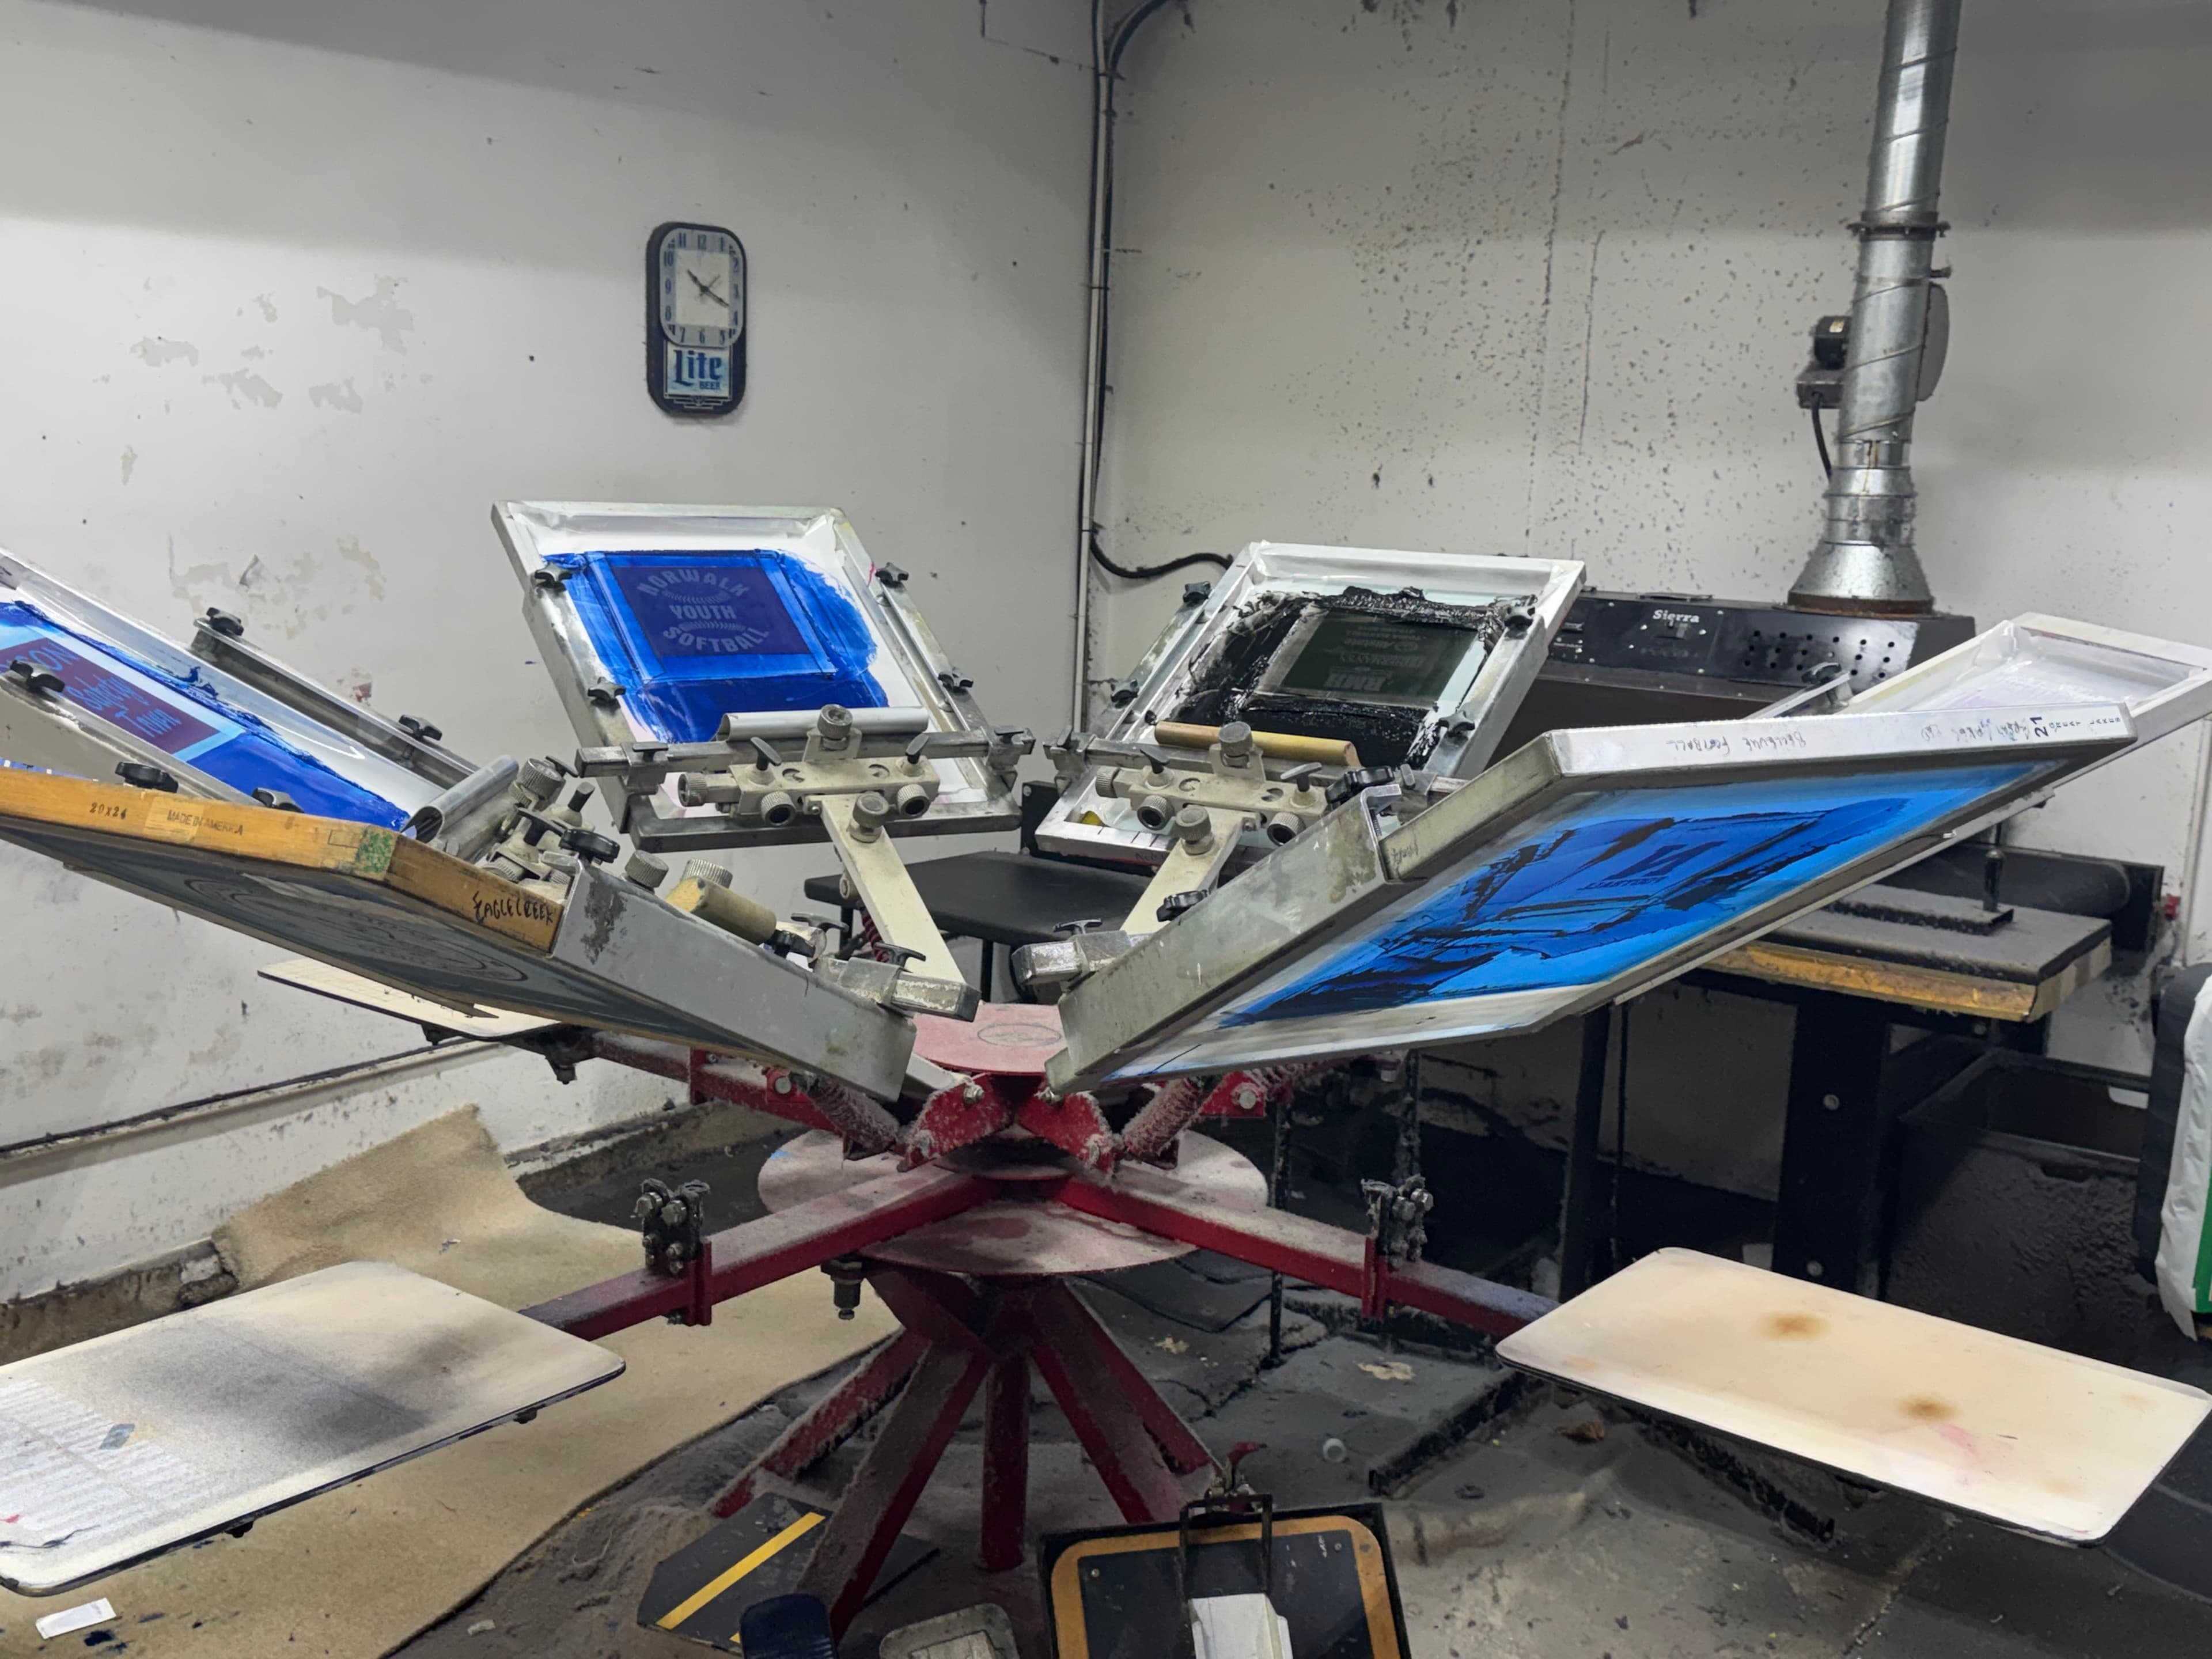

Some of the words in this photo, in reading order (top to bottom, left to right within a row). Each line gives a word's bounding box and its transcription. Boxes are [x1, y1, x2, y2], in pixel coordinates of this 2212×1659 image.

[698, 234, 707, 249] 12
[664, 251, 673, 266] 10
[665, 279, 671, 294] 9
[699, 329, 705, 344] 6
[673, 350, 722, 387] Lite
[699, 381, 721, 390] BEER
[637, 568, 749, 598] NORWALK
[669, 605, 736, 620] YOUTH
[1653, 609, 1700, 623] Sierra
[662, 626, 770, 653] SOFTBALL
[2030, 717, 2049, 737] 21
[167, 809, 191, 825] MADE
[192, 815, 203, 827] IN
